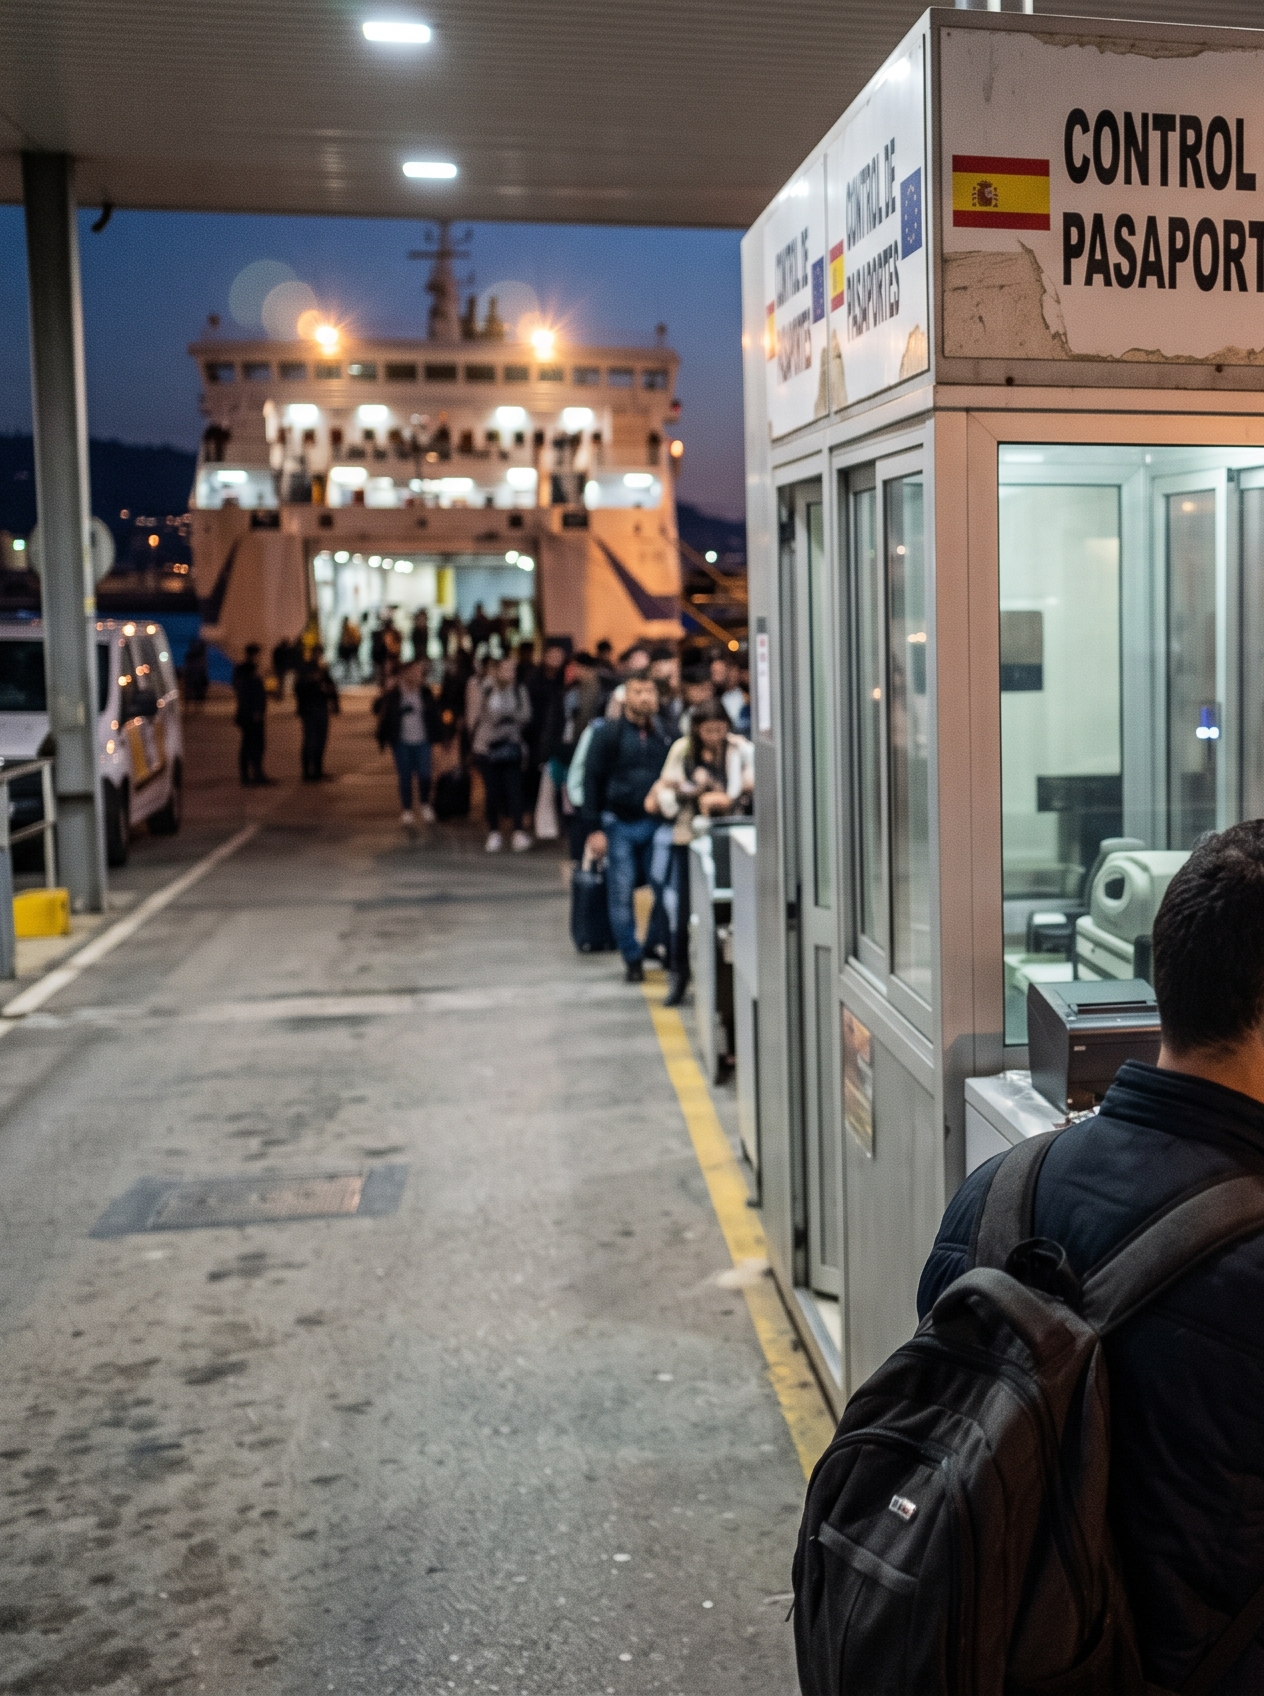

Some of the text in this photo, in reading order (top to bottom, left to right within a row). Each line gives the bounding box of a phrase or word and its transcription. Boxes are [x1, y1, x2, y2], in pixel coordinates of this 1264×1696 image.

[846, 136, 896, 252] CONTROL DE
[1064, 107, 1257, 191] CONTROL
[847, 239, 900, 343] PASAPORTES
